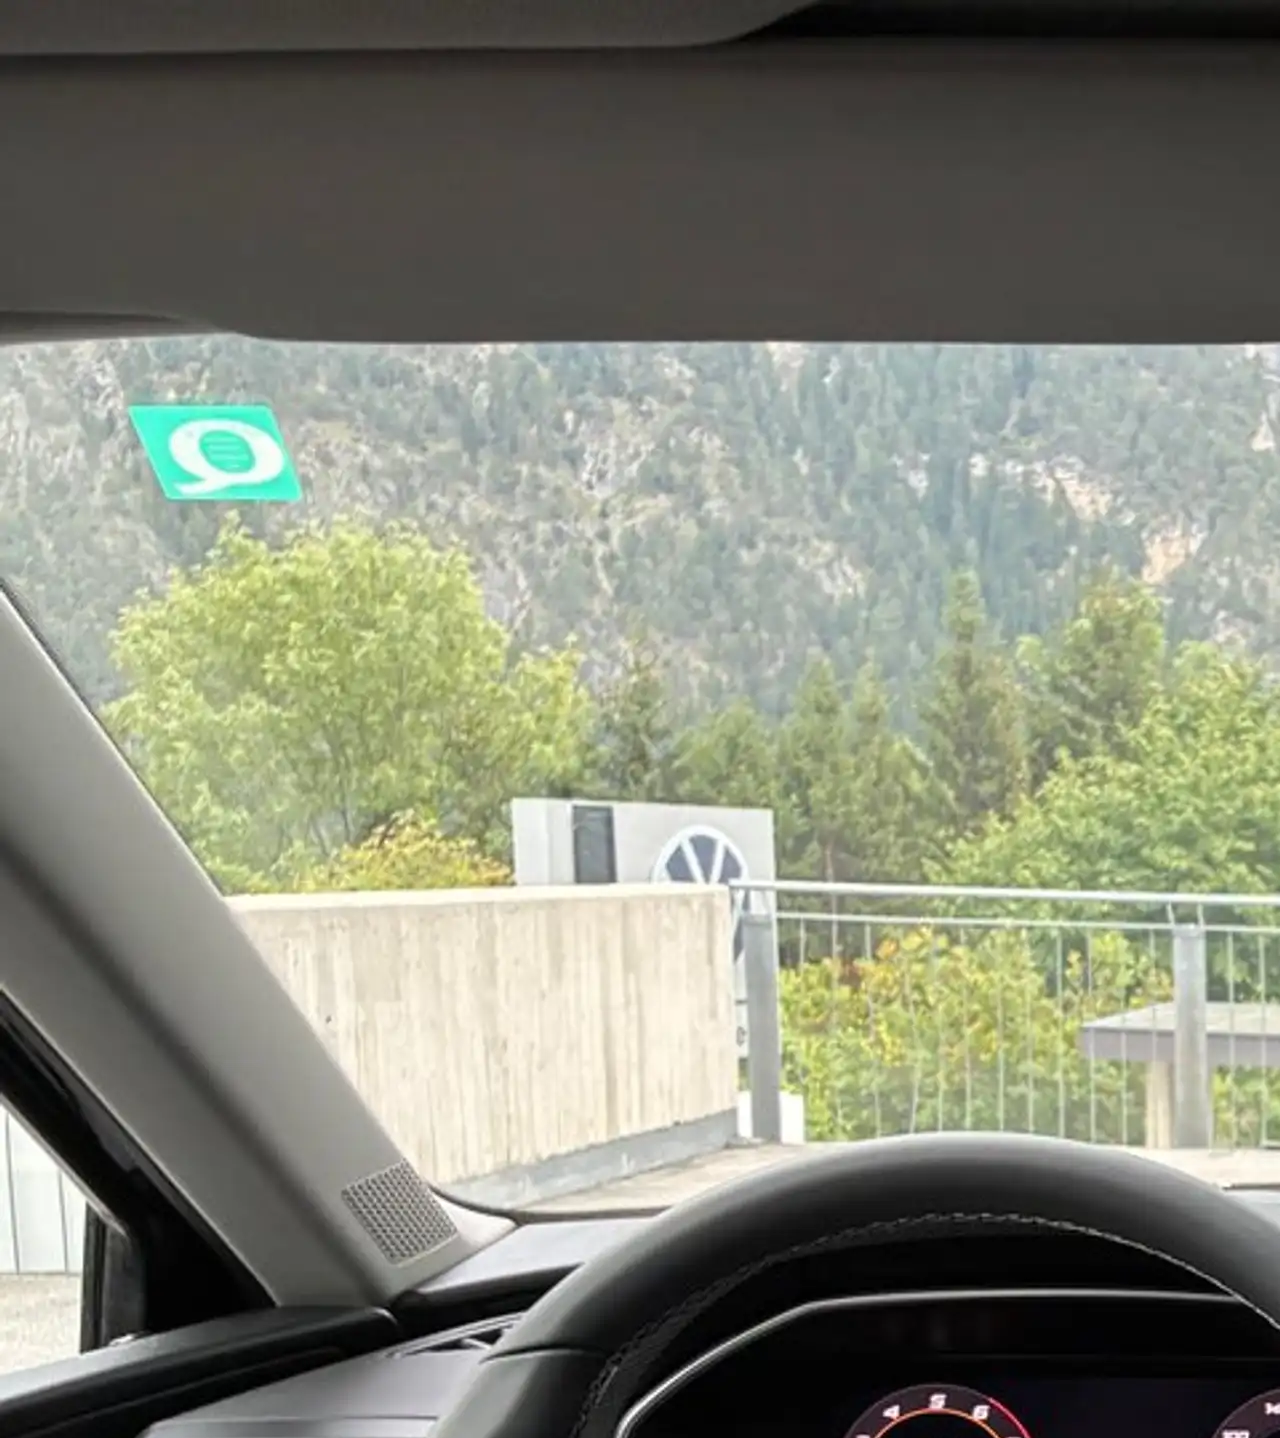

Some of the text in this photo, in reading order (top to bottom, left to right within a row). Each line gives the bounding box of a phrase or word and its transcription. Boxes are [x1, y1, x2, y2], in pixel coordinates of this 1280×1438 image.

[929, 1394, 946, 1409] 5
[883, 1405, 900, 1419] 4
[972, 1404, 990, 1420] 6
